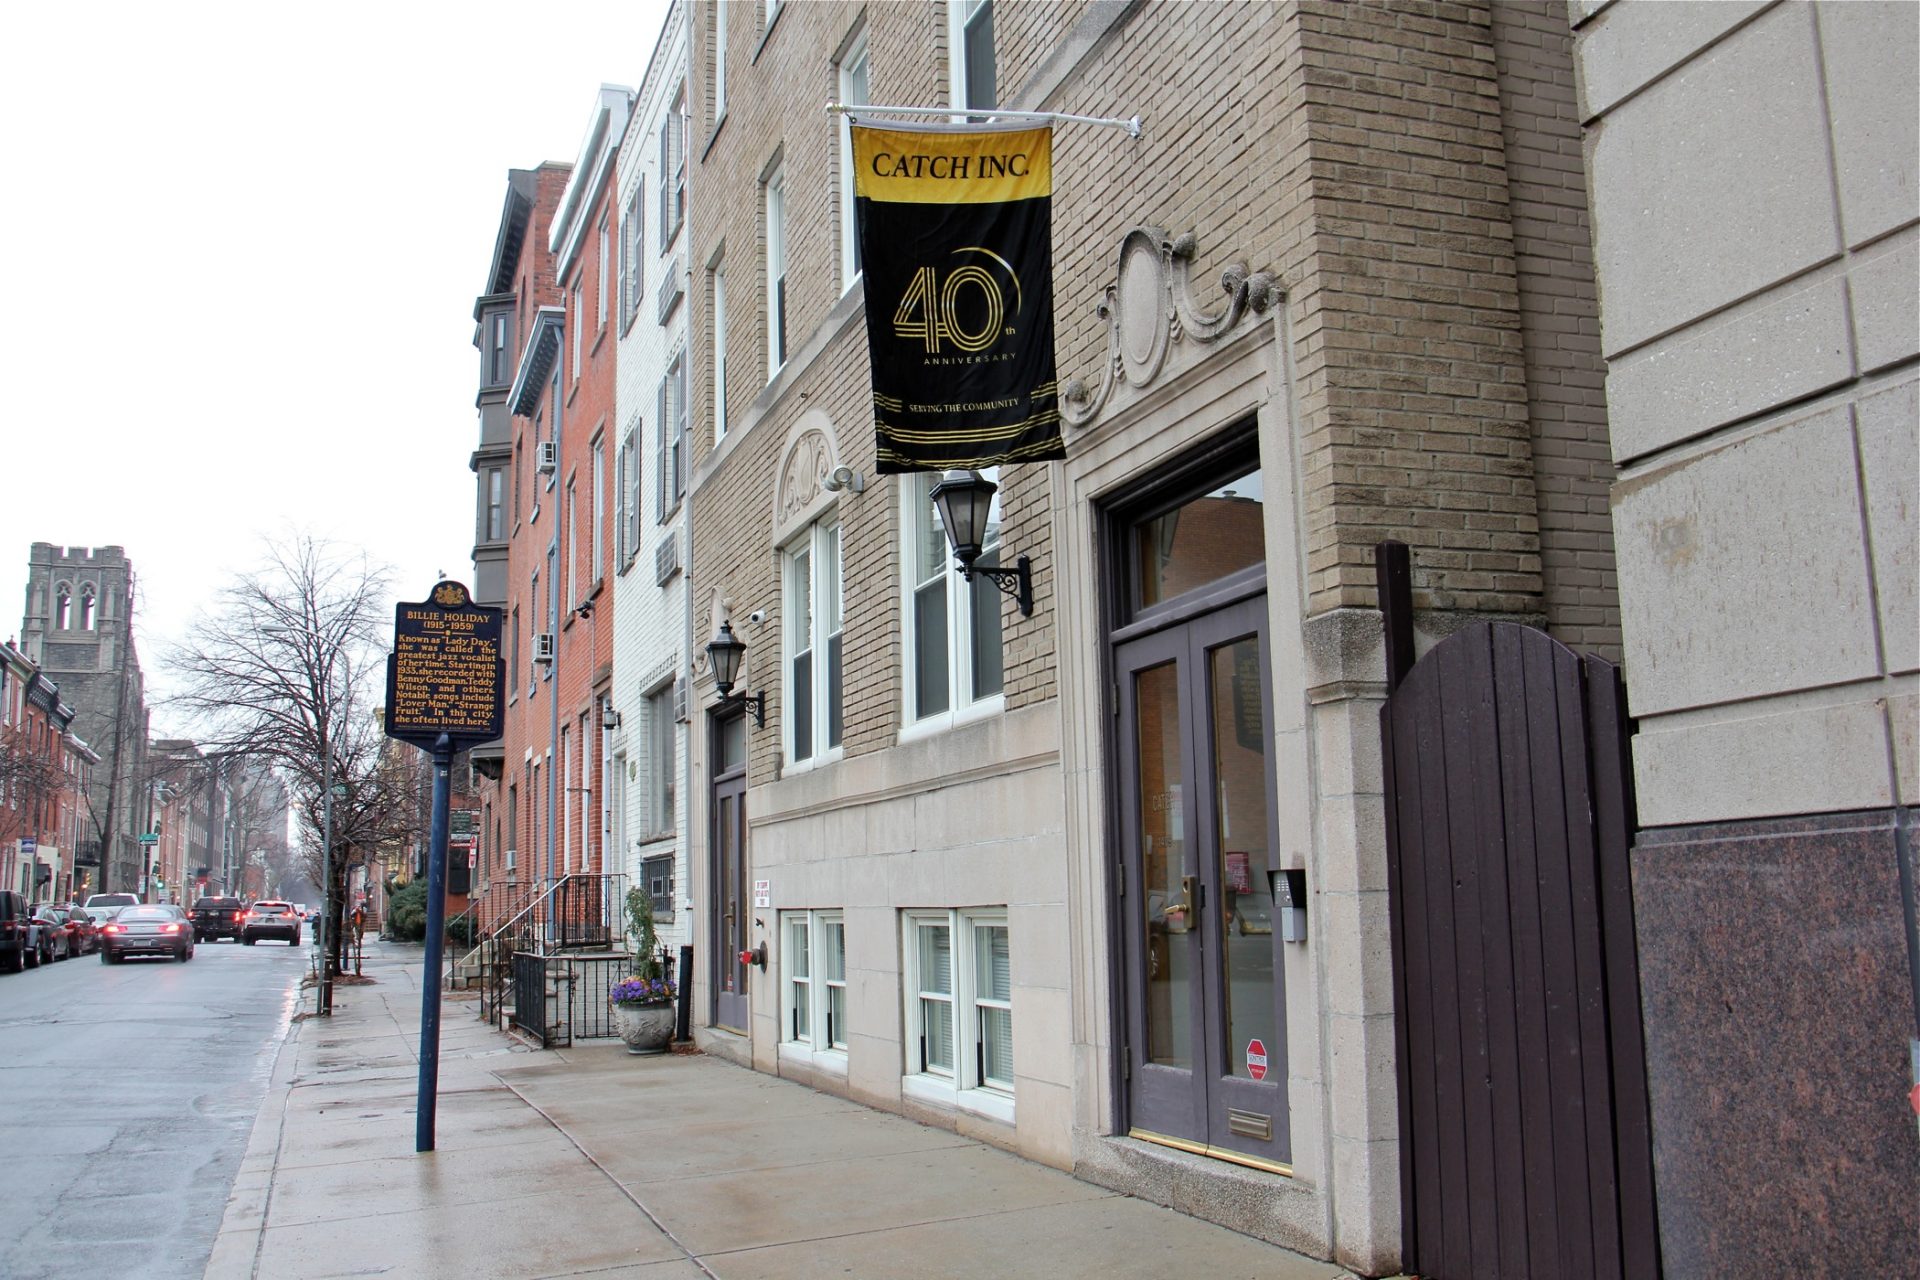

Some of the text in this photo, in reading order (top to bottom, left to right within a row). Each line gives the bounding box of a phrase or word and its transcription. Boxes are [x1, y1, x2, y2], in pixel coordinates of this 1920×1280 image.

[872, 152, 1030, 179] CATCH INC.
[924, 353, 1016, 365] ANNIVERSARY
[909, 398, 1019, 413] SERVING THE COMMUNITY
[407, 611, 490, 623] BILLIE HOLIDAY
[399, 634, 429, 643] Known
[421, 644, 438, 652] was
[445, 645, 473, 653] called
[481, 646, 497, 654] the
[397, 652, 496, 662] greatest jazz vocalist
[408, 659, 424, 667] her
[425, 660, 447, 669] time.
[448, 660, 487, 670] Starting
[487, 662, 496, 670] in
[419, 667, 434, 675] she
[434, 669, 475, 677] recorded
[476, 670, 496, 678] with
[397, 674, 425, 684] Benny
[467, 677, 495, 687] Teddy
[462, 686, 495, 694] others.
[396, 690, 495, 702] Notable songs include
[434, 708, 444, 716] In
[450, 708, 467, 717] this
[395, 715, 490, 726] she often lived here.
